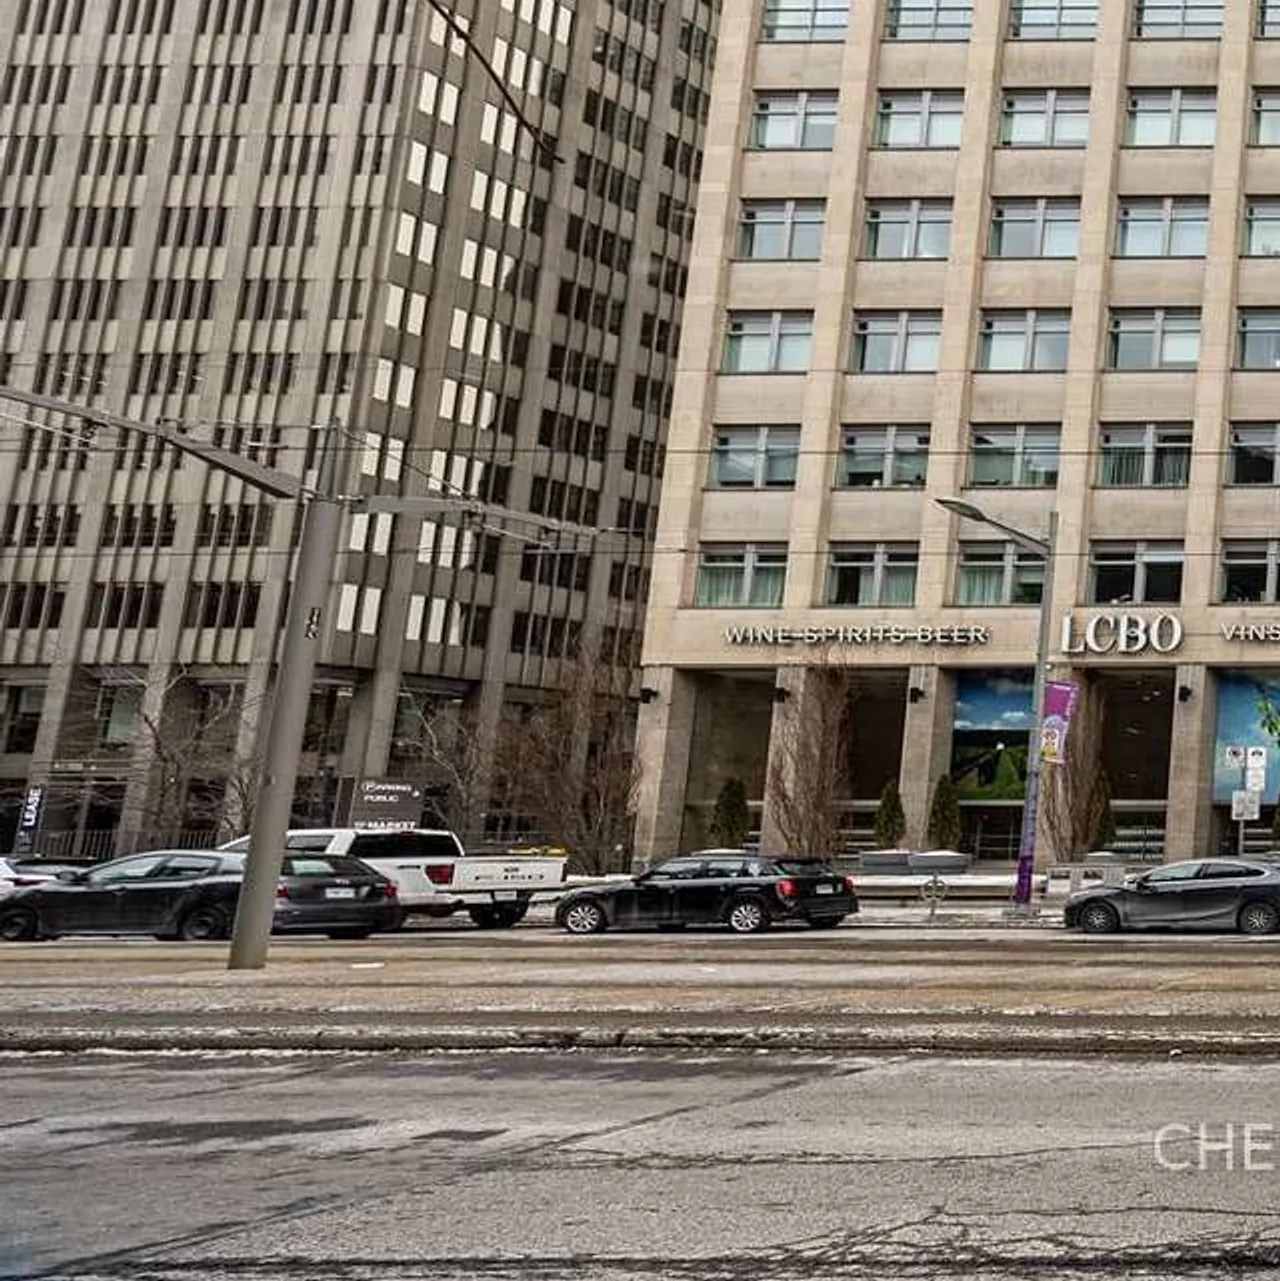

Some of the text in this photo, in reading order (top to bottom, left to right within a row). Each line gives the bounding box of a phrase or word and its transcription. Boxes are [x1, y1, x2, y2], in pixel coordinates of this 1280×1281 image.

[725, 624, 988, 644] WINE SPIRITS BEER
[1061, 613, 1183, 654] LCBO
[22, 787, 42, 827] LEASE
